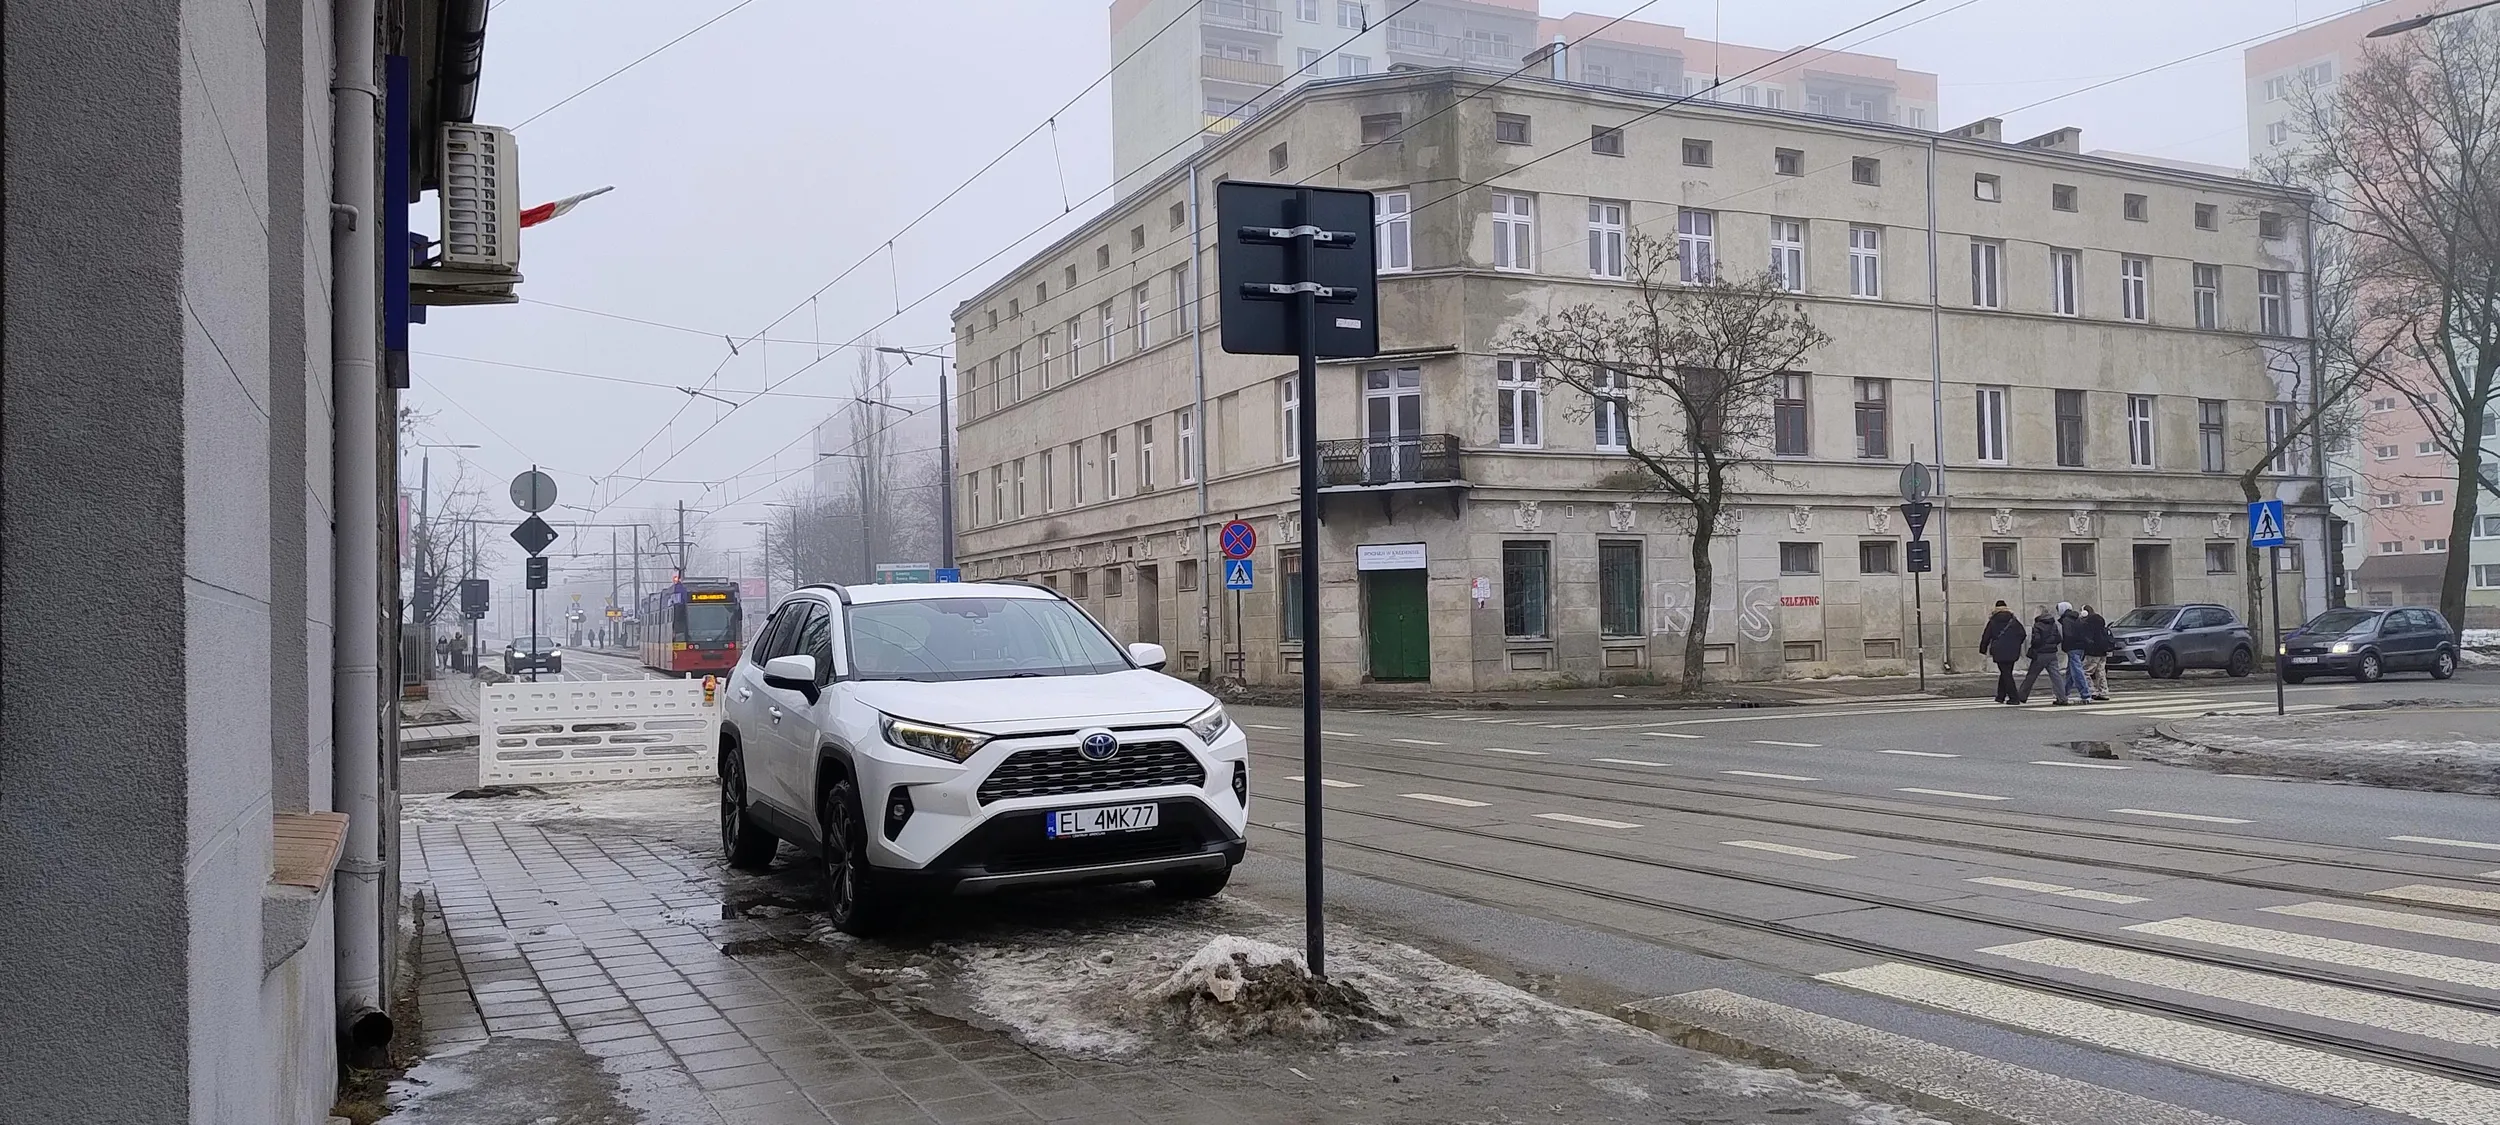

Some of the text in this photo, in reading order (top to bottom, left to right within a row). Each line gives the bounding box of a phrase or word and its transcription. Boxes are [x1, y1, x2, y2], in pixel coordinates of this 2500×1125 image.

[1780, 596, 1820, 607] SZLEZYNG
[1060, 805, 1154, 833] EL 4MK77
